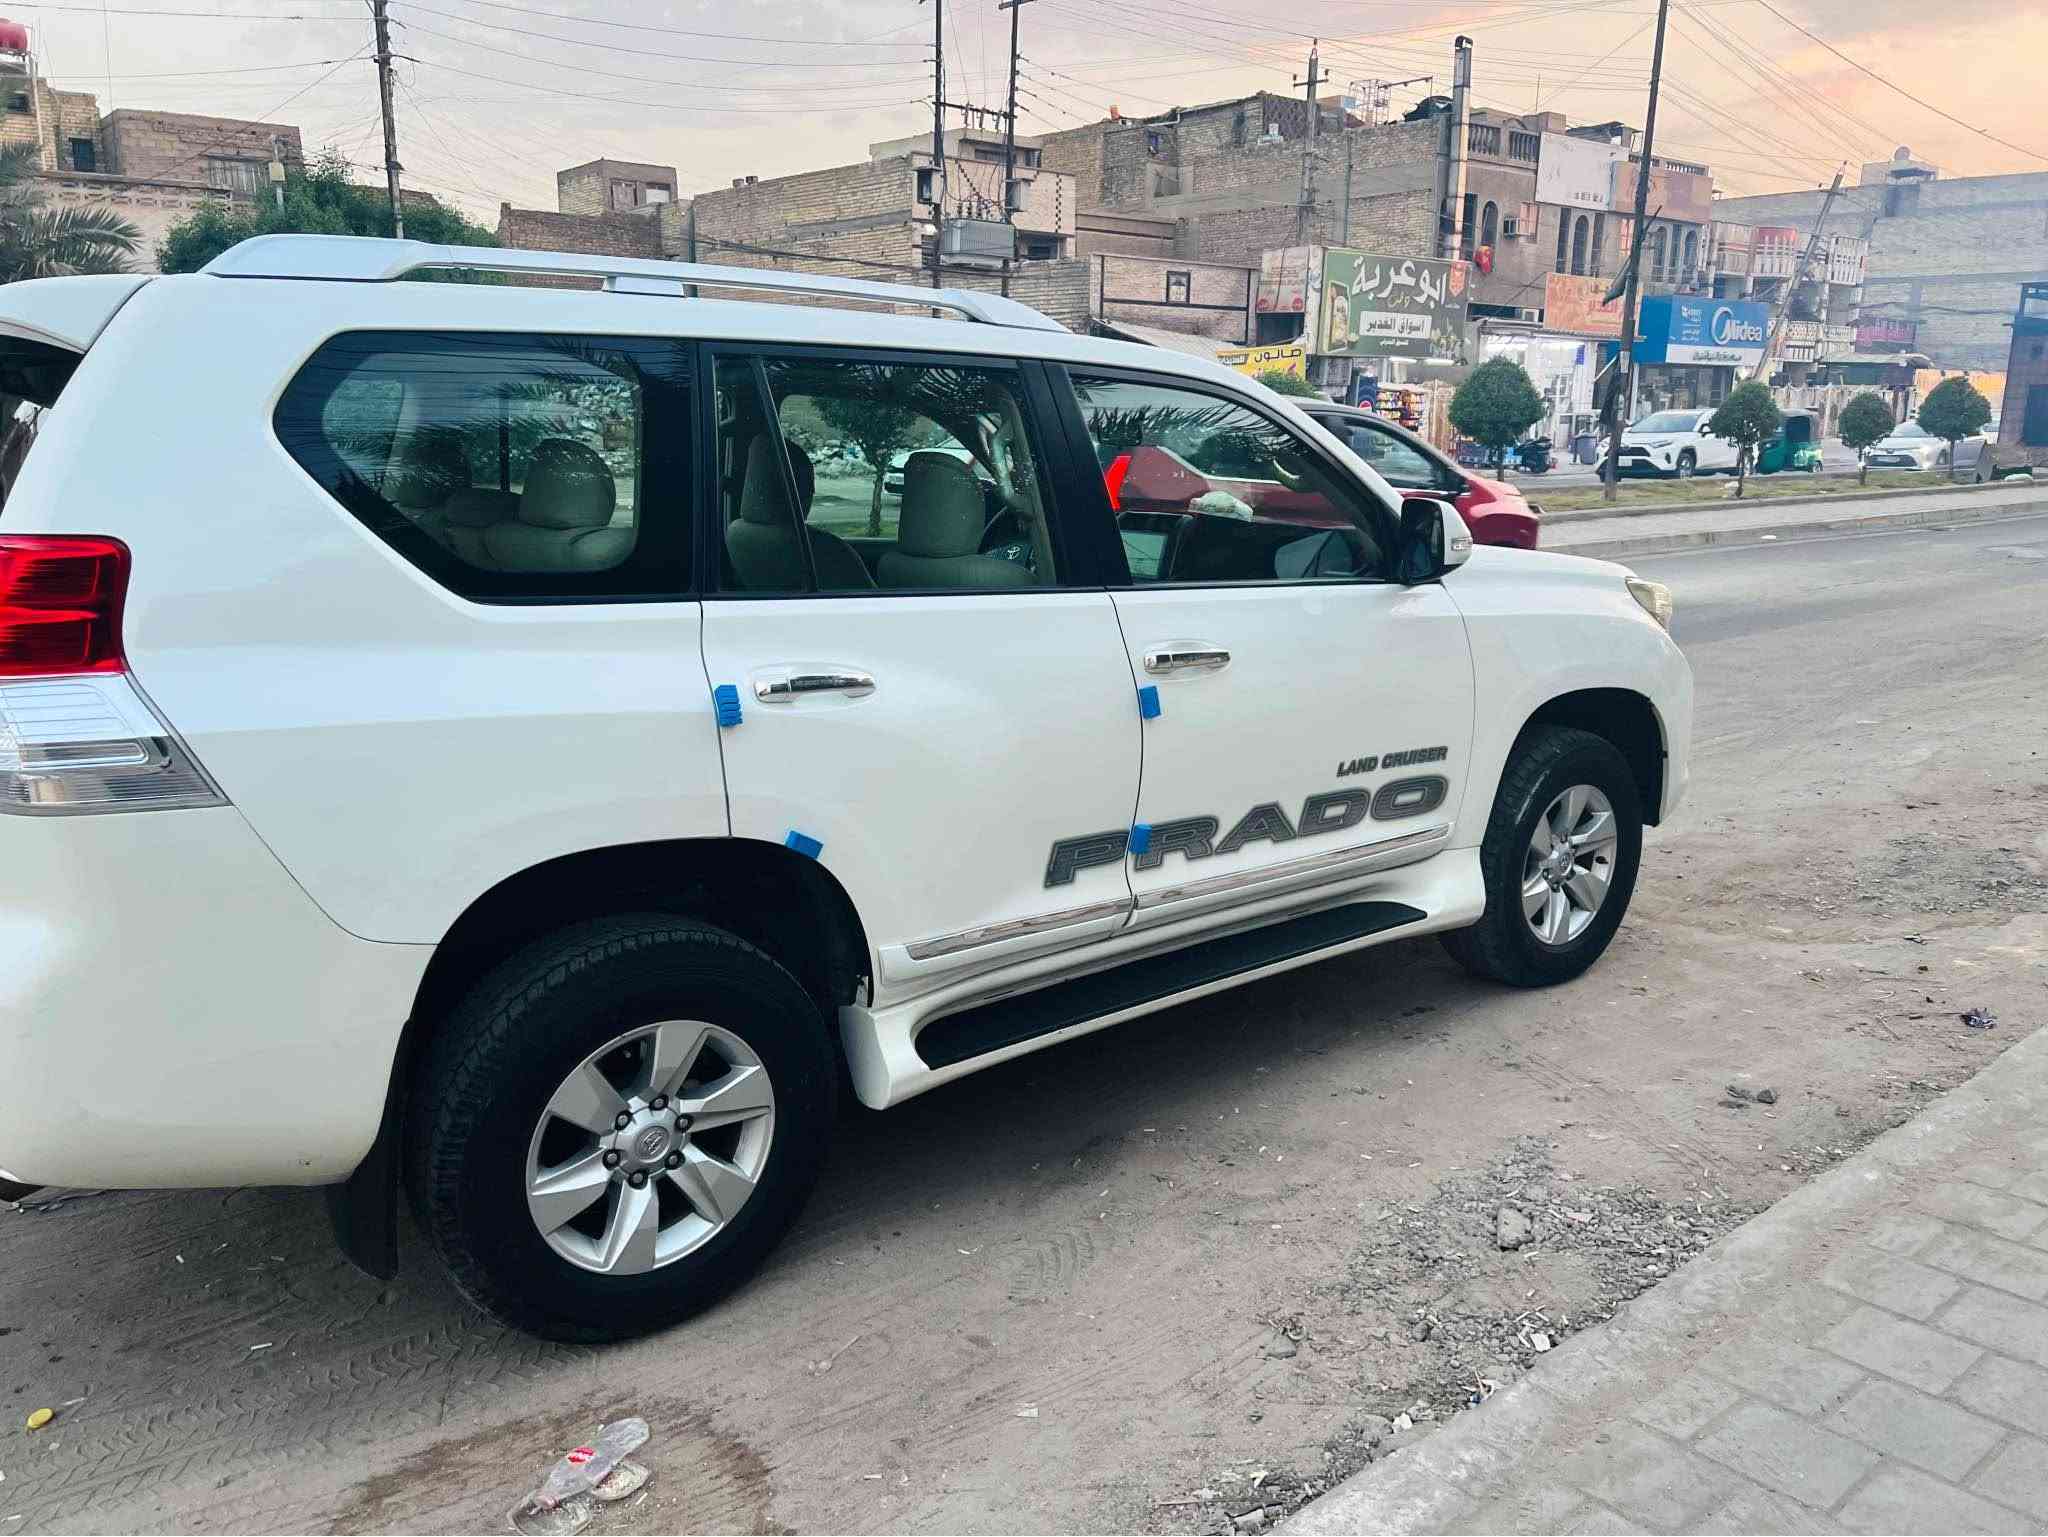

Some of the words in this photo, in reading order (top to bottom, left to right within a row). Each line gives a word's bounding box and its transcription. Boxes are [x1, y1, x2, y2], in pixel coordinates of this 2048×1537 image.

[1412, 268, 1447, 309] ابو
[1711, 306, 1762, 345] Midea
[1254, 347, 1302, 363] صالون
[1336, 755, 1378, 777] LAND
[1381, 745, 1448, 769] CRUISER
[1043, 774, 1450, 888] PRADO
